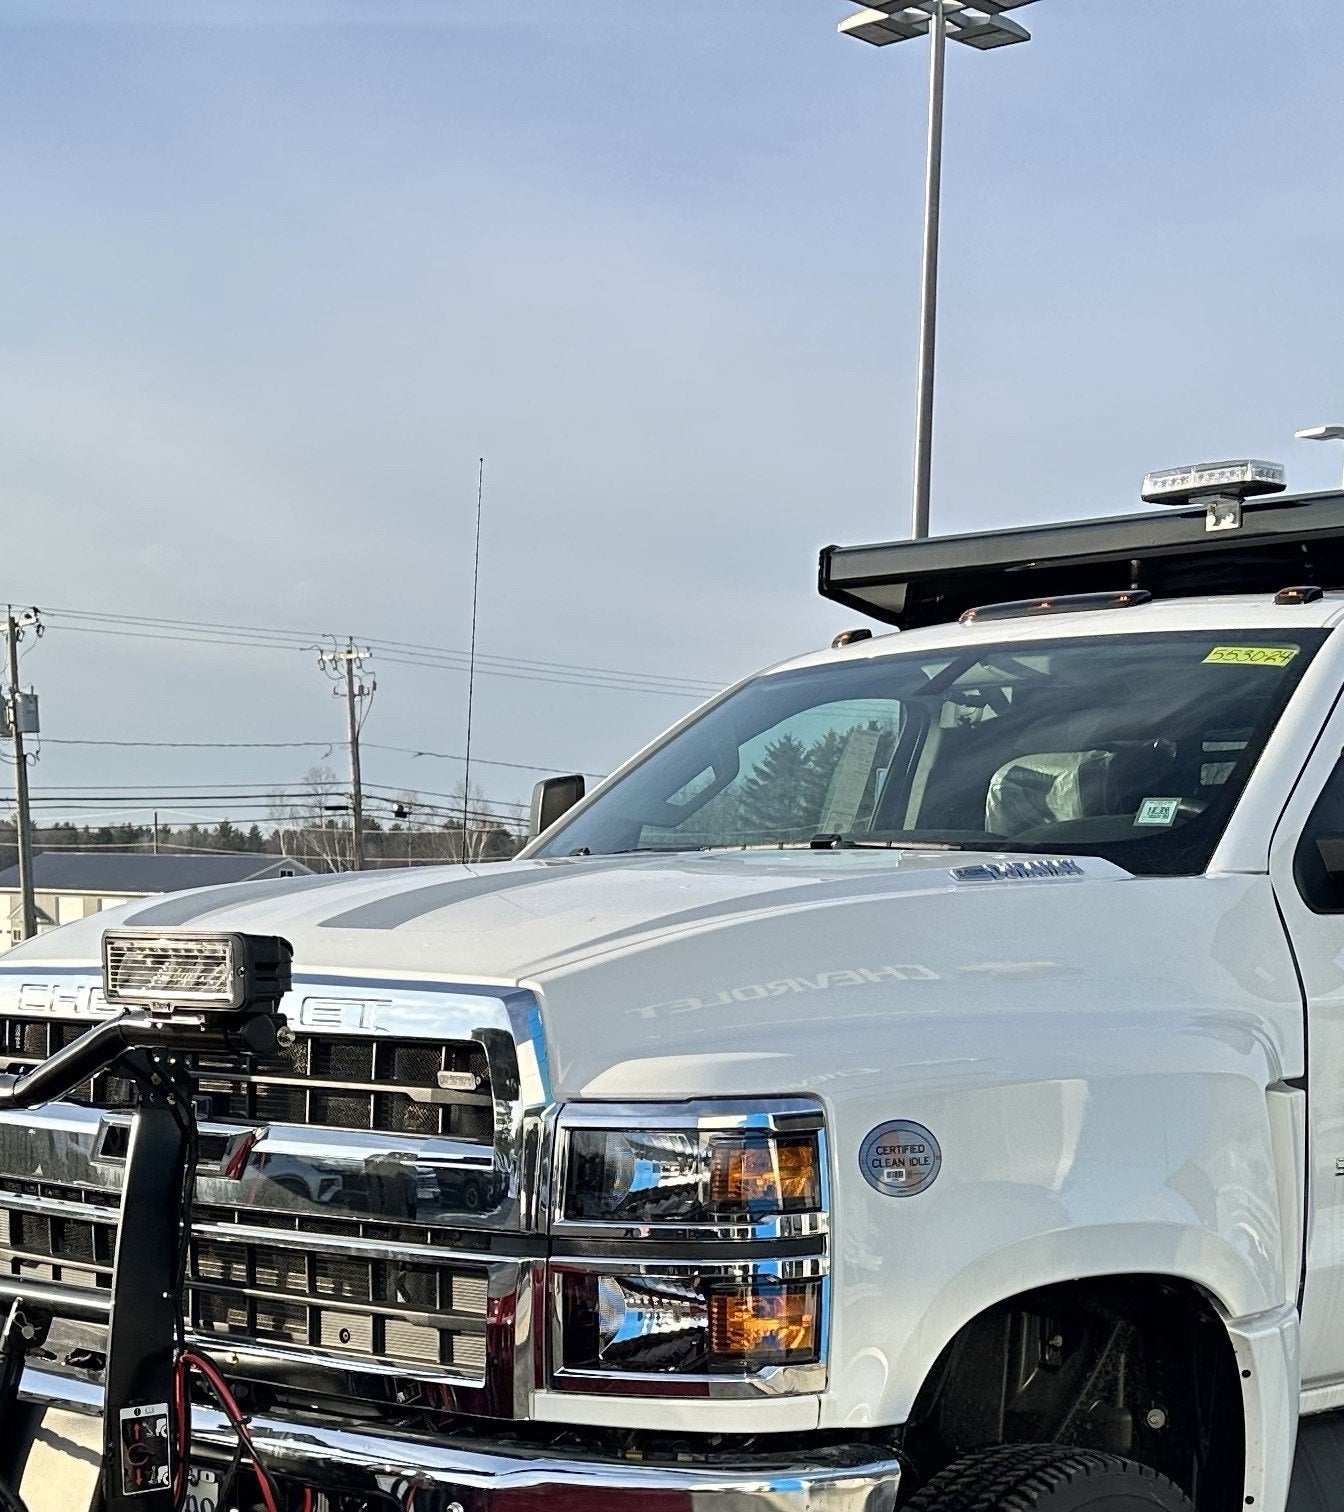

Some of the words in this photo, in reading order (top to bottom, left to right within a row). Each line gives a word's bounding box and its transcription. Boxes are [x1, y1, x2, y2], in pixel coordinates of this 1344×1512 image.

[875, 1144, 925, 1156] CERTIFIED
[871, 1157, 906, 1168] CLEAN
[909, 1156, 931, 1166] IDLE
